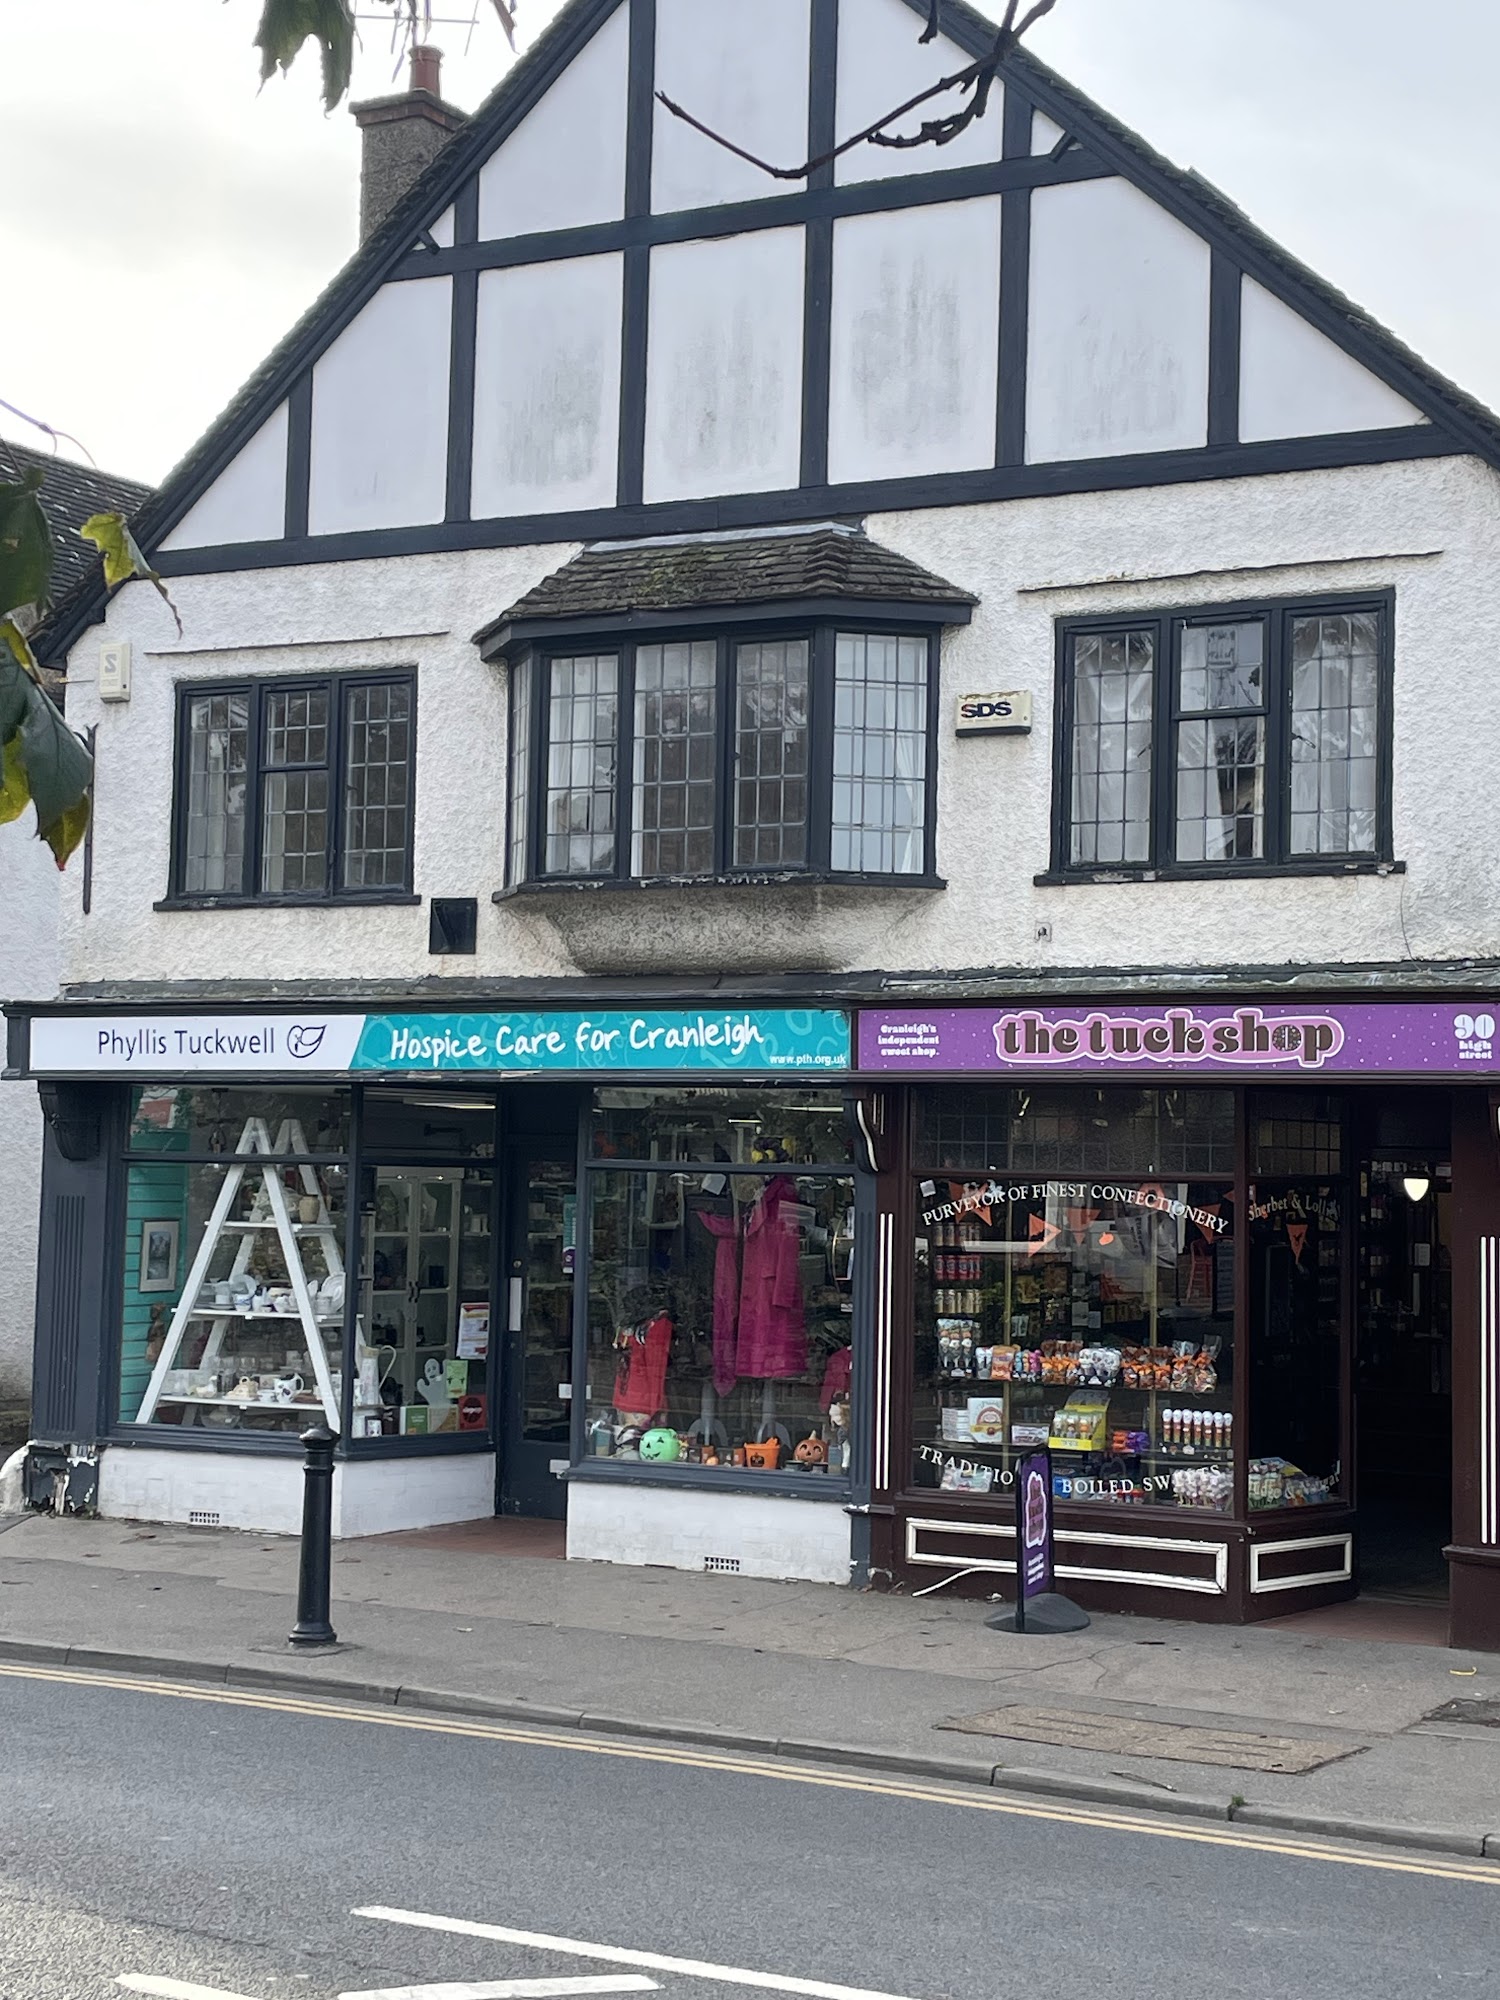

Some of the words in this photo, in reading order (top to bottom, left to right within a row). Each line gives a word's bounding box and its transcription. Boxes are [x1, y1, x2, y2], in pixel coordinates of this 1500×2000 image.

[961, 701, 1012, 718] SDS
[880, 1023, 937, 1035] Cranleigh's
[1453, 1013, 1496, 1040] 90
[98, 1029, 167, 1061] Phyllis
[174, 1028, 274, 1053] Tuckwell
[391, 1028, 487, 1067] Hospice
[496, 1026, 566, 1055] Care
[576, 1022, 620, 1051] for
[629, 1015, 764, 1055] Cranleigh
[878, 1035, 940, 1047] independent
[1002, 1018, 1079, 1053] the
[1086, 1015, 1205, 1054] tuck
[1212, 1015, 1334, 1062] shop
[1459, 1040, 1492, 1051] high
[769, 1053, 847, 1067] www.pth.org.uk
[881, 1047, 910, 1056] sweet
[1459, 1050, 1493, 1060] street
[922, 1190, 1006, 1226] PURVEYOR
[1008, 1186, 1029, 1201] OF
[1031, 1183, 1087, 1199] FINEST
[1091, 1184, 1230, 1234] CONFECTIONERY
[920, 1444, 1014, 1485] TRADITIO
[1061, 1478, 1134, 1495] BOILED
